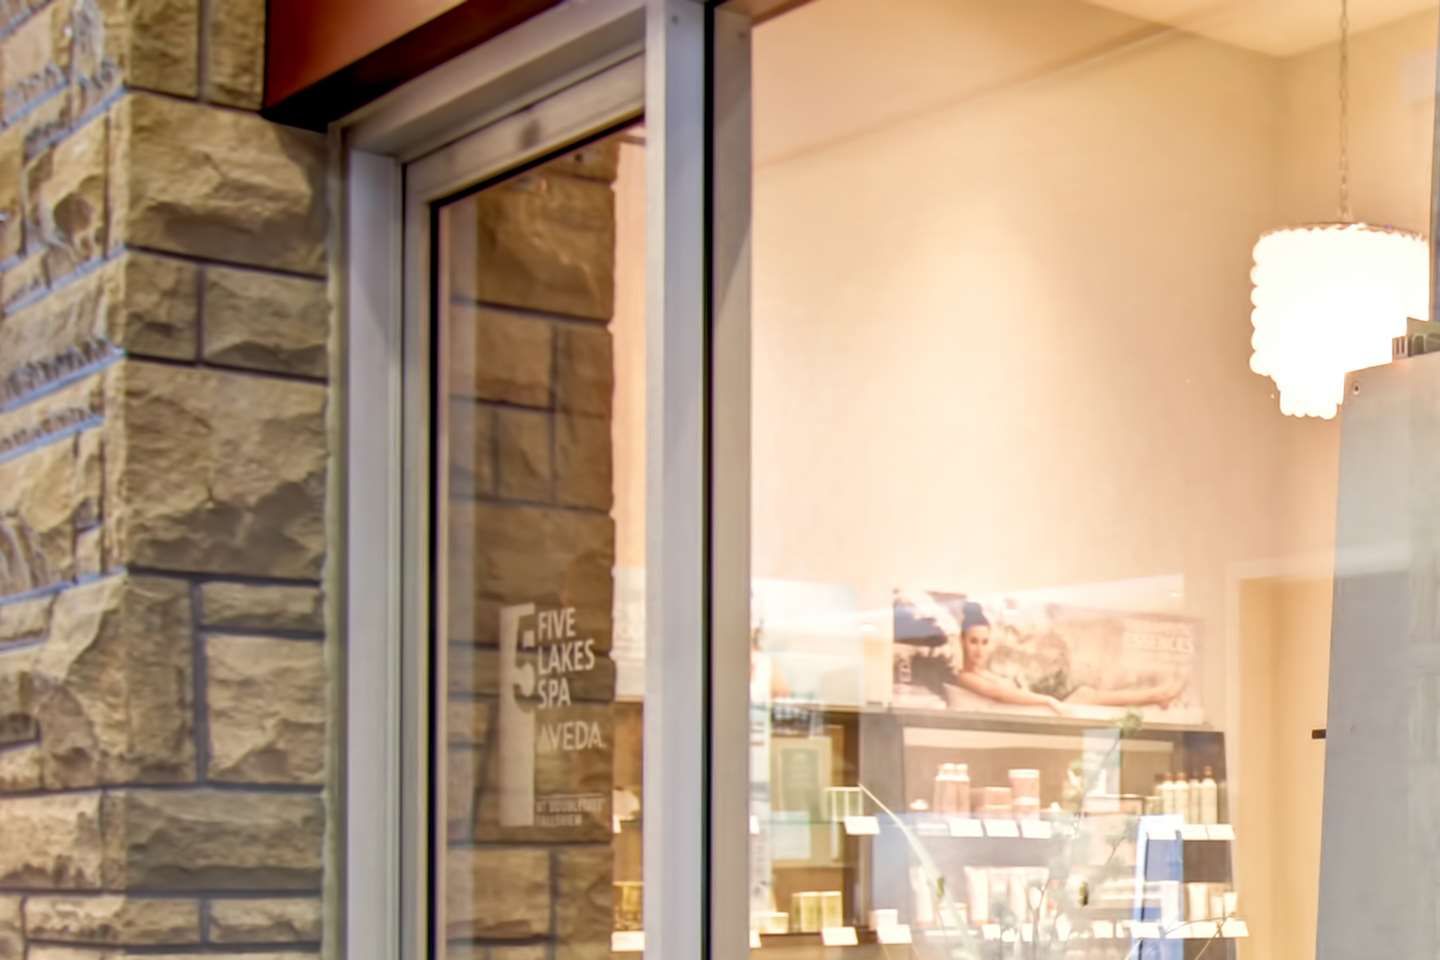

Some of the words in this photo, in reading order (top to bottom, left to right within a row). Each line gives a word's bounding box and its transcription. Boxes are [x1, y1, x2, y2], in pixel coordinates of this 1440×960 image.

[537, 607, 576, 641] FIVE
[537, 638, 595, 676] LAKES
[537, 677, 571, 709] SPA
